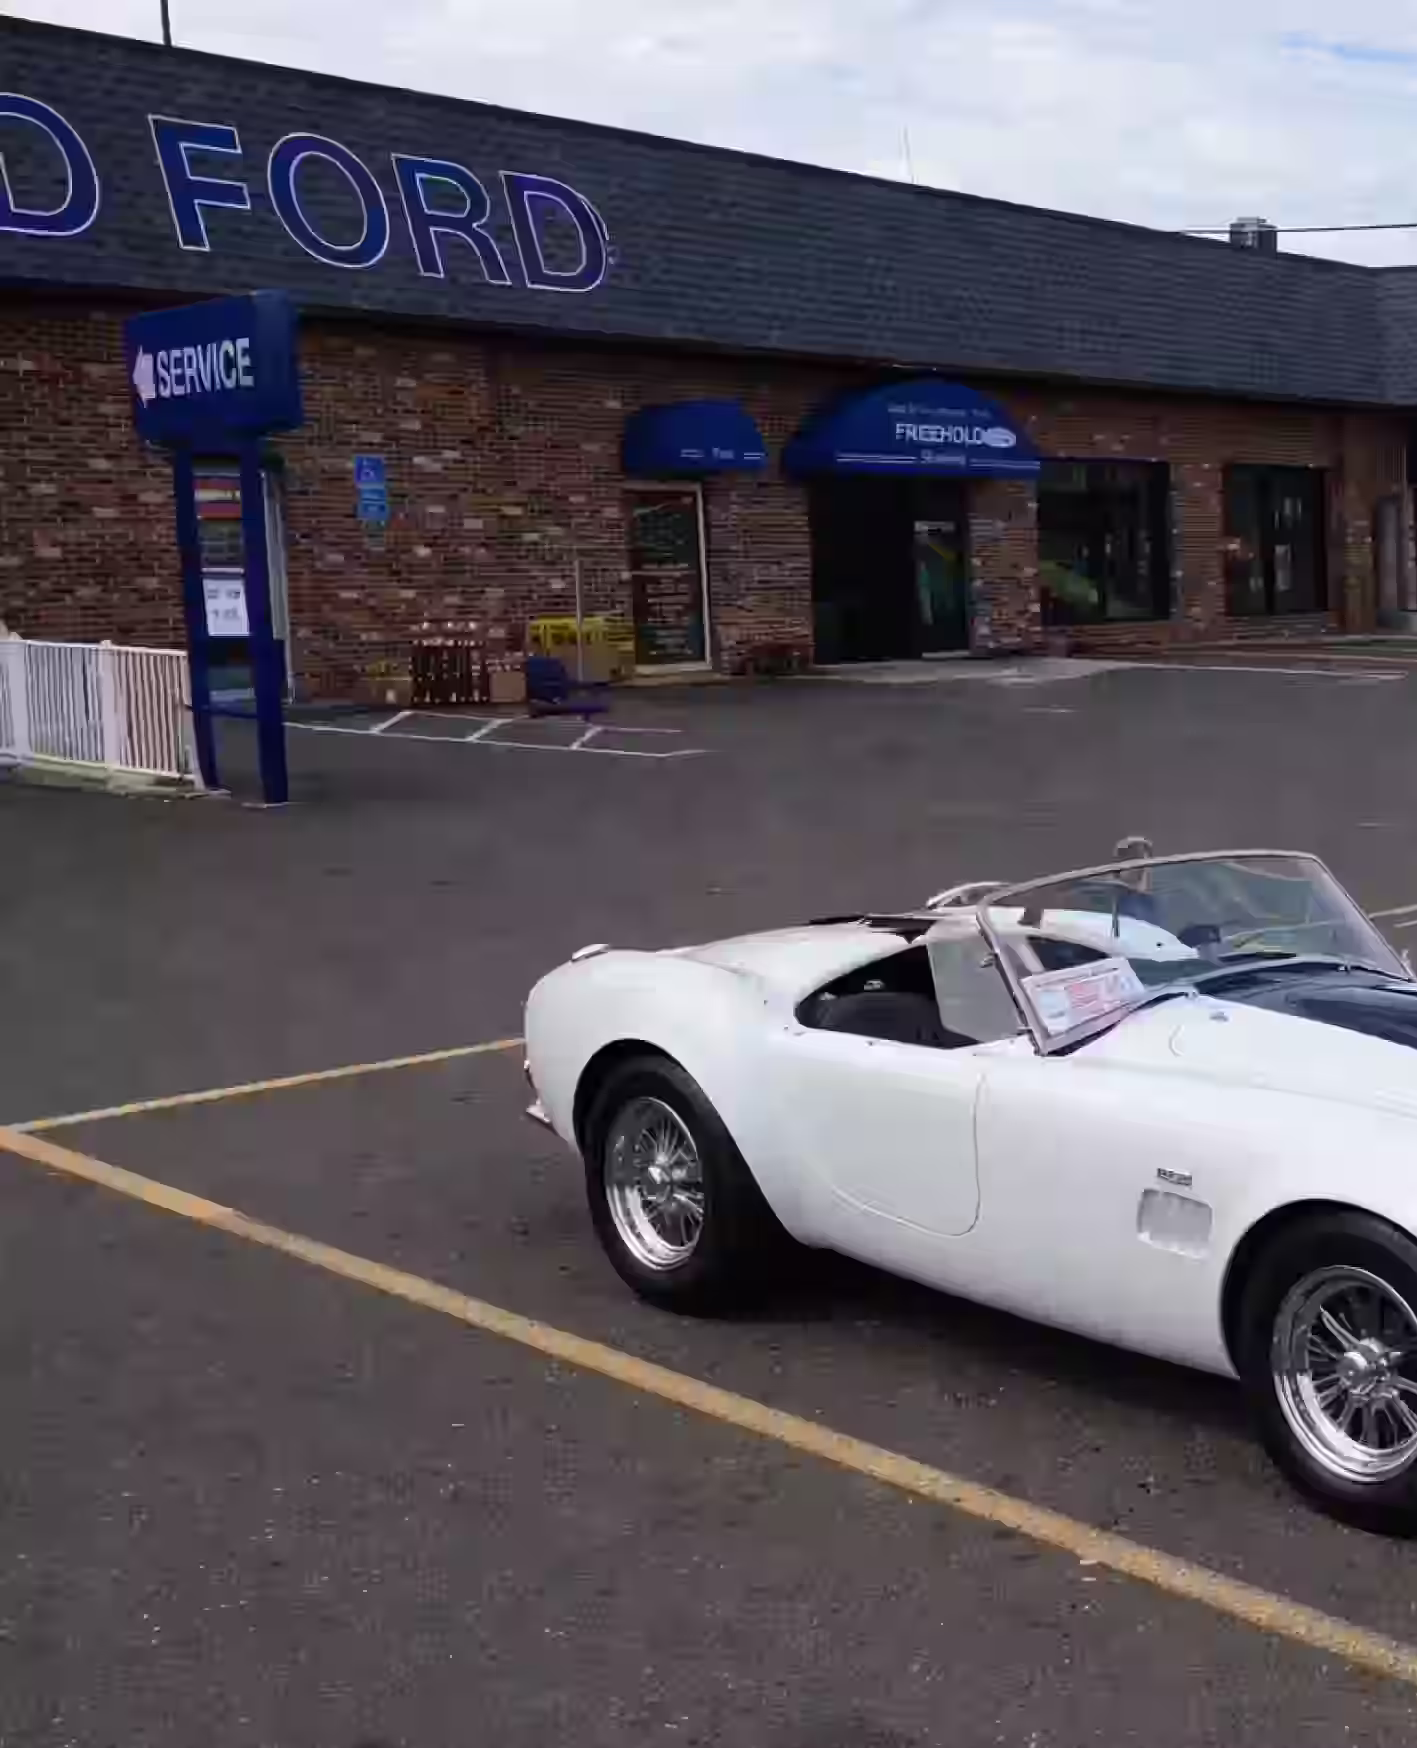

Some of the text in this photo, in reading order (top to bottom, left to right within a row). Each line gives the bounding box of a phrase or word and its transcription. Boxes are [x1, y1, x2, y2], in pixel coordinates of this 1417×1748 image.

[148, 114, 609, 292] FORD
[157, 338, 254, 398] SERVICE
[896, 423, 983, 445] FREEHOLD
